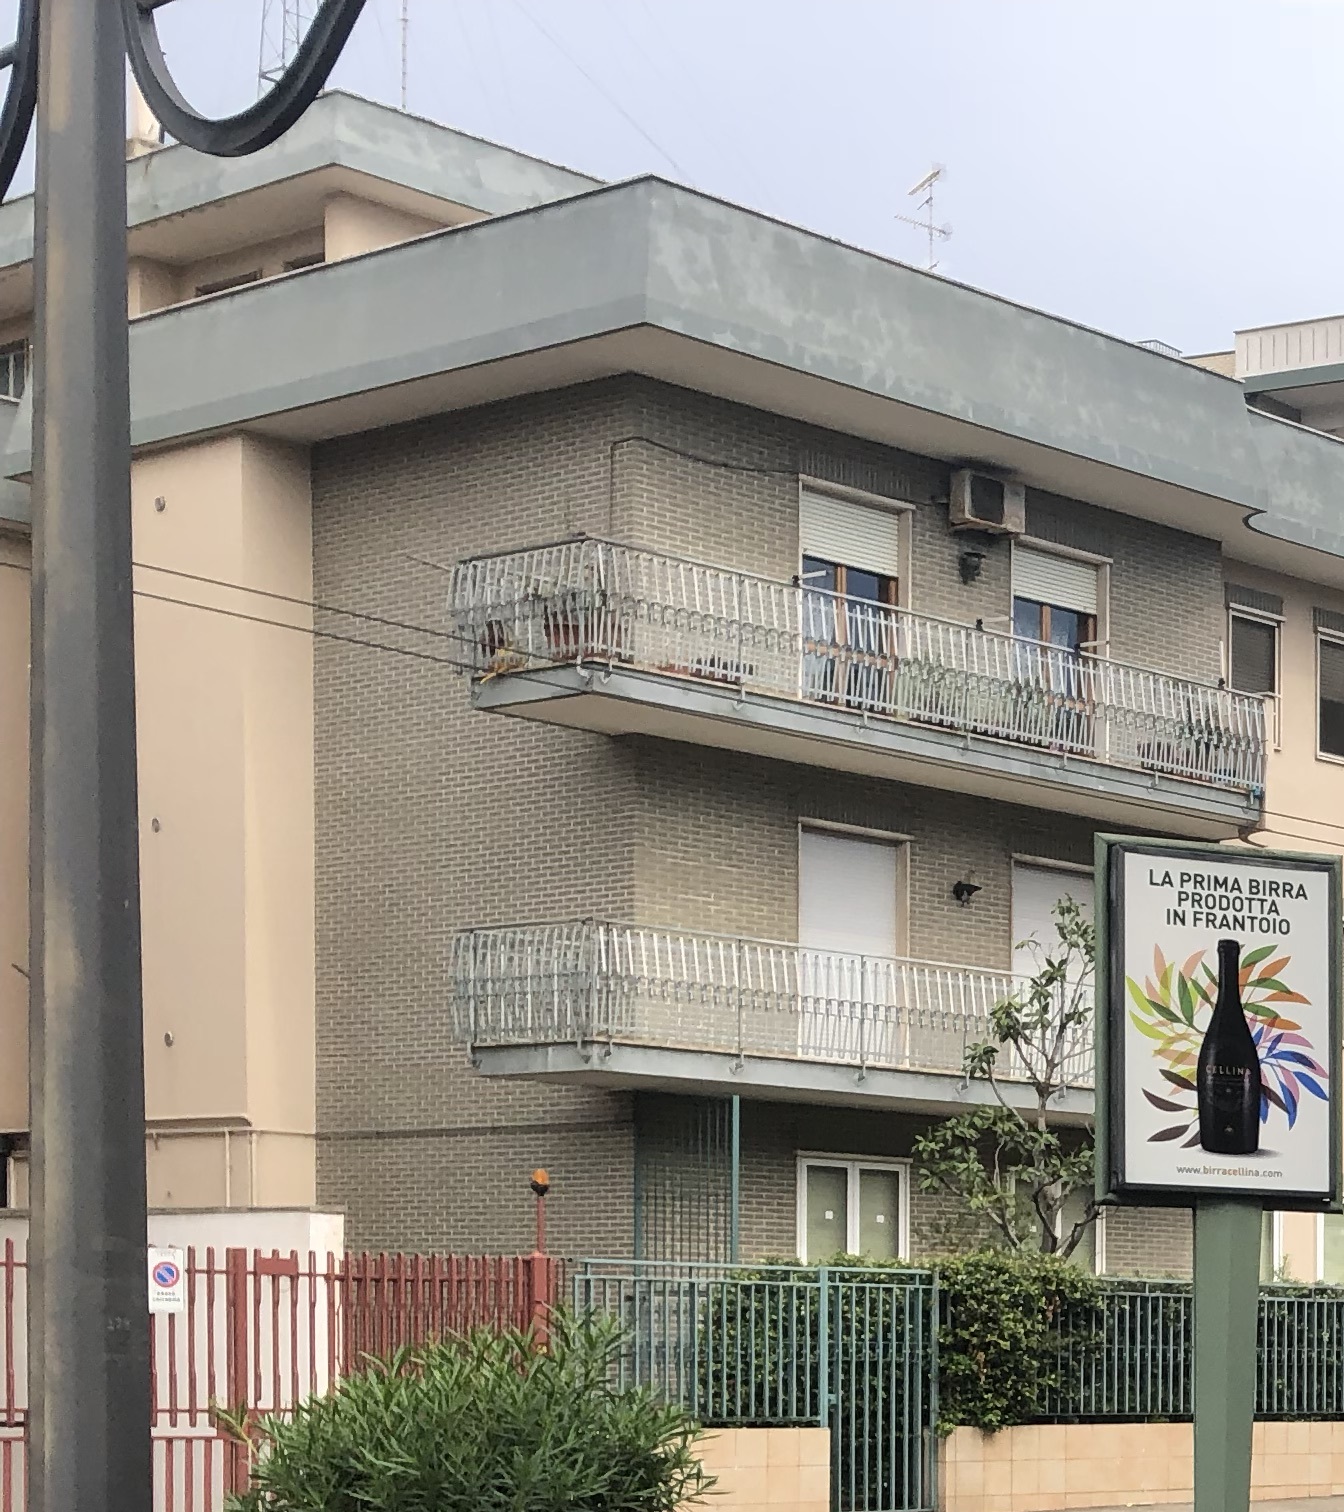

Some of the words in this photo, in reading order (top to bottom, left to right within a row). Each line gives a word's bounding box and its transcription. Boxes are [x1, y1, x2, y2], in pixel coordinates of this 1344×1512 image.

[1149, 868, 1174, 888] LA
[1179, 871, 1243, 894] PRIMA
[1249, 878, 1308, 901] BIRRA
[1177, 890, 1281, 916] PRODOTTA
[1166, 908, 1186, 927] IN
[1193, 911, 1291, 936] FRANTOIO
[1176, 1165, 1283, 1178] www.birracellina.com
